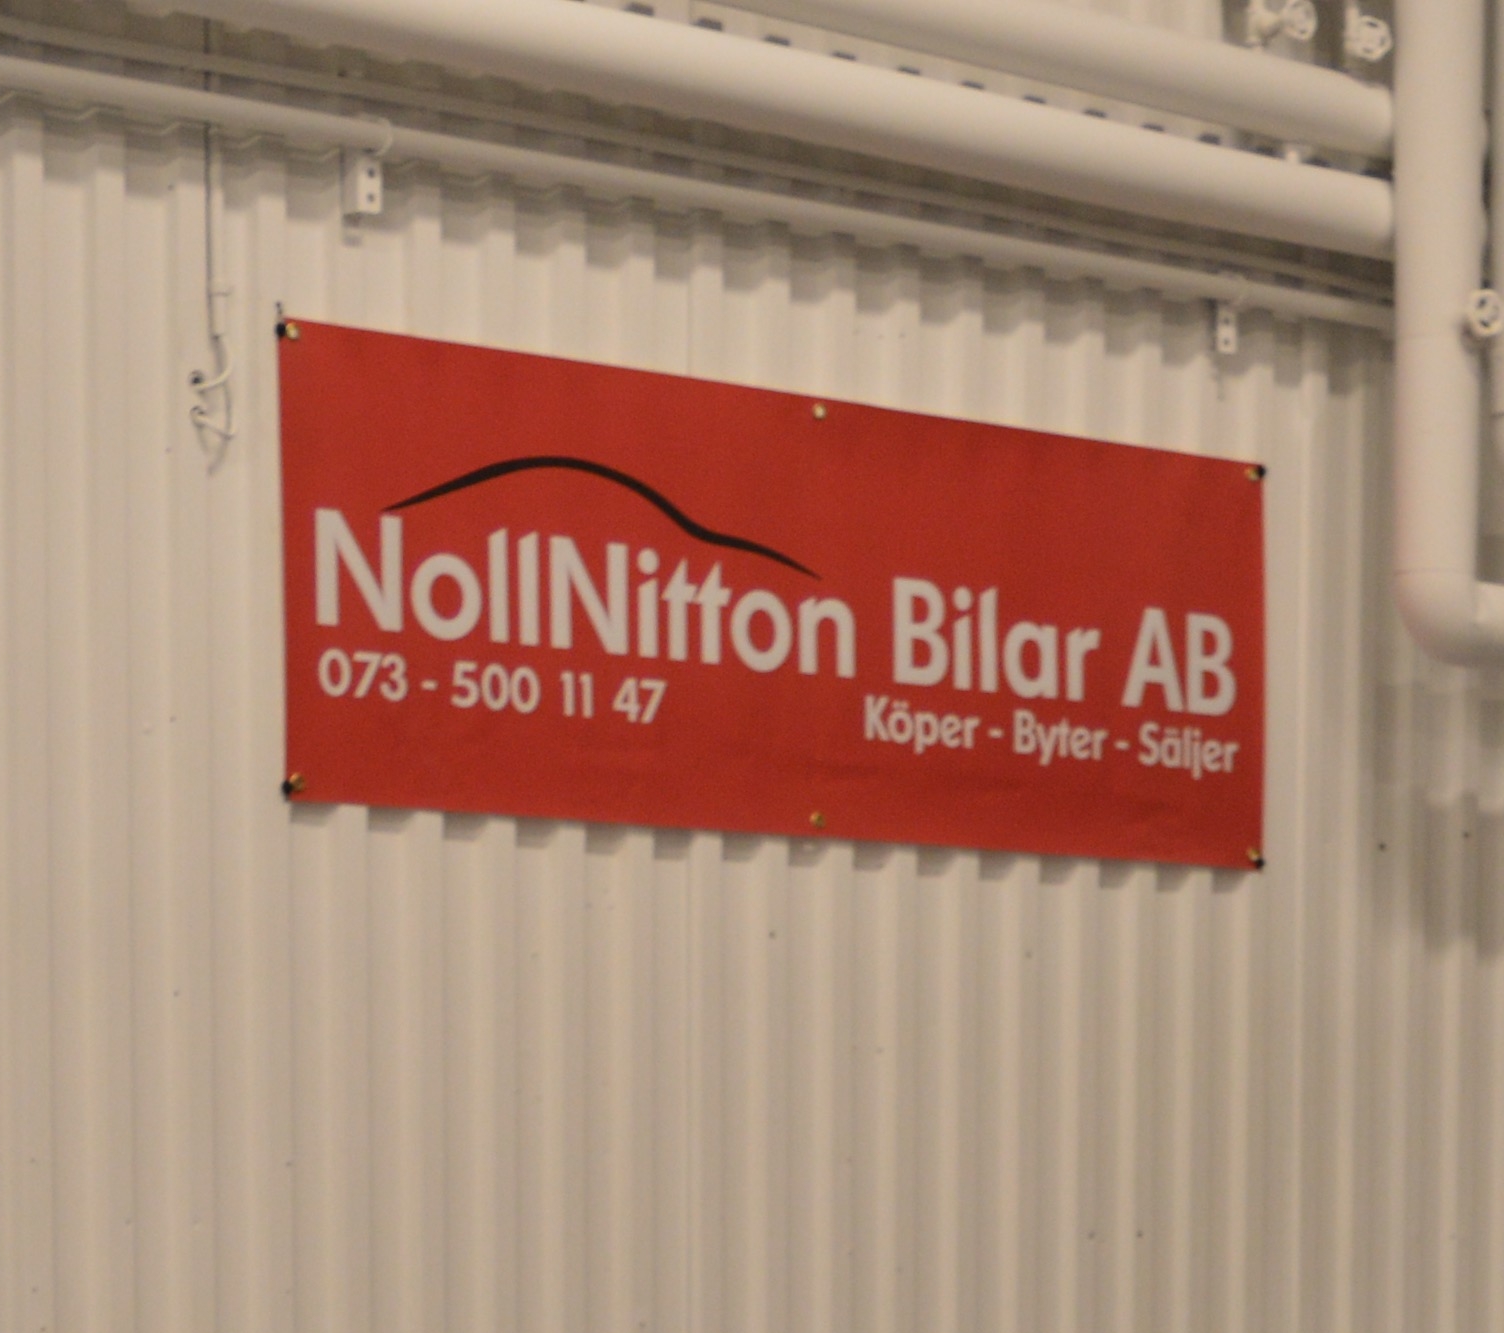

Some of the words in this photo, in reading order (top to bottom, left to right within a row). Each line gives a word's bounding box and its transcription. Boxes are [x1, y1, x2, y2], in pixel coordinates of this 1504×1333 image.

[314, 508, 856, 679] NollNitton
[893, 577, 1101, 704] Bilar
[1122, 608, 1237, 716] AB
[318, 648, 408, 702] 073
[451, 665, 540, 716] 500
[562, 673, 594, 720] 11
[613, 679, 667, 725] 47
[864, 694, 979, 756] Köper
[1013, 709, 1106, 766] Byter
[1138, 723, 1240, 780] Säljer
